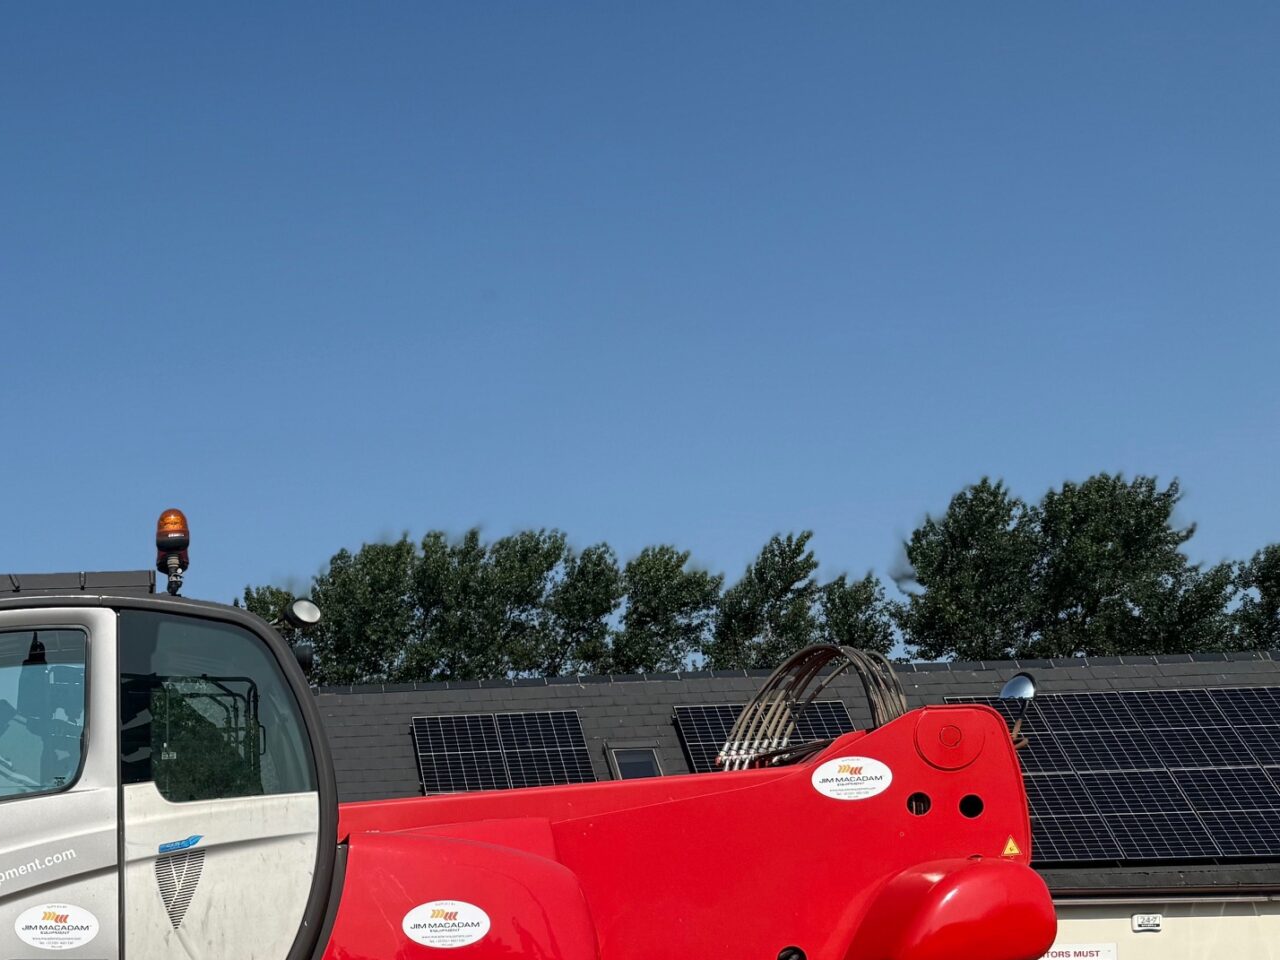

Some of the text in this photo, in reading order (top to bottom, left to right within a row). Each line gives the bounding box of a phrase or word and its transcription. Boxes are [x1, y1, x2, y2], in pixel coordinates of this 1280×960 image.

[835, 775, 883, 783] MACADAM
[428, 921, 481, 929] MACADAM
[1073, 950, 1100, 958] MUST
